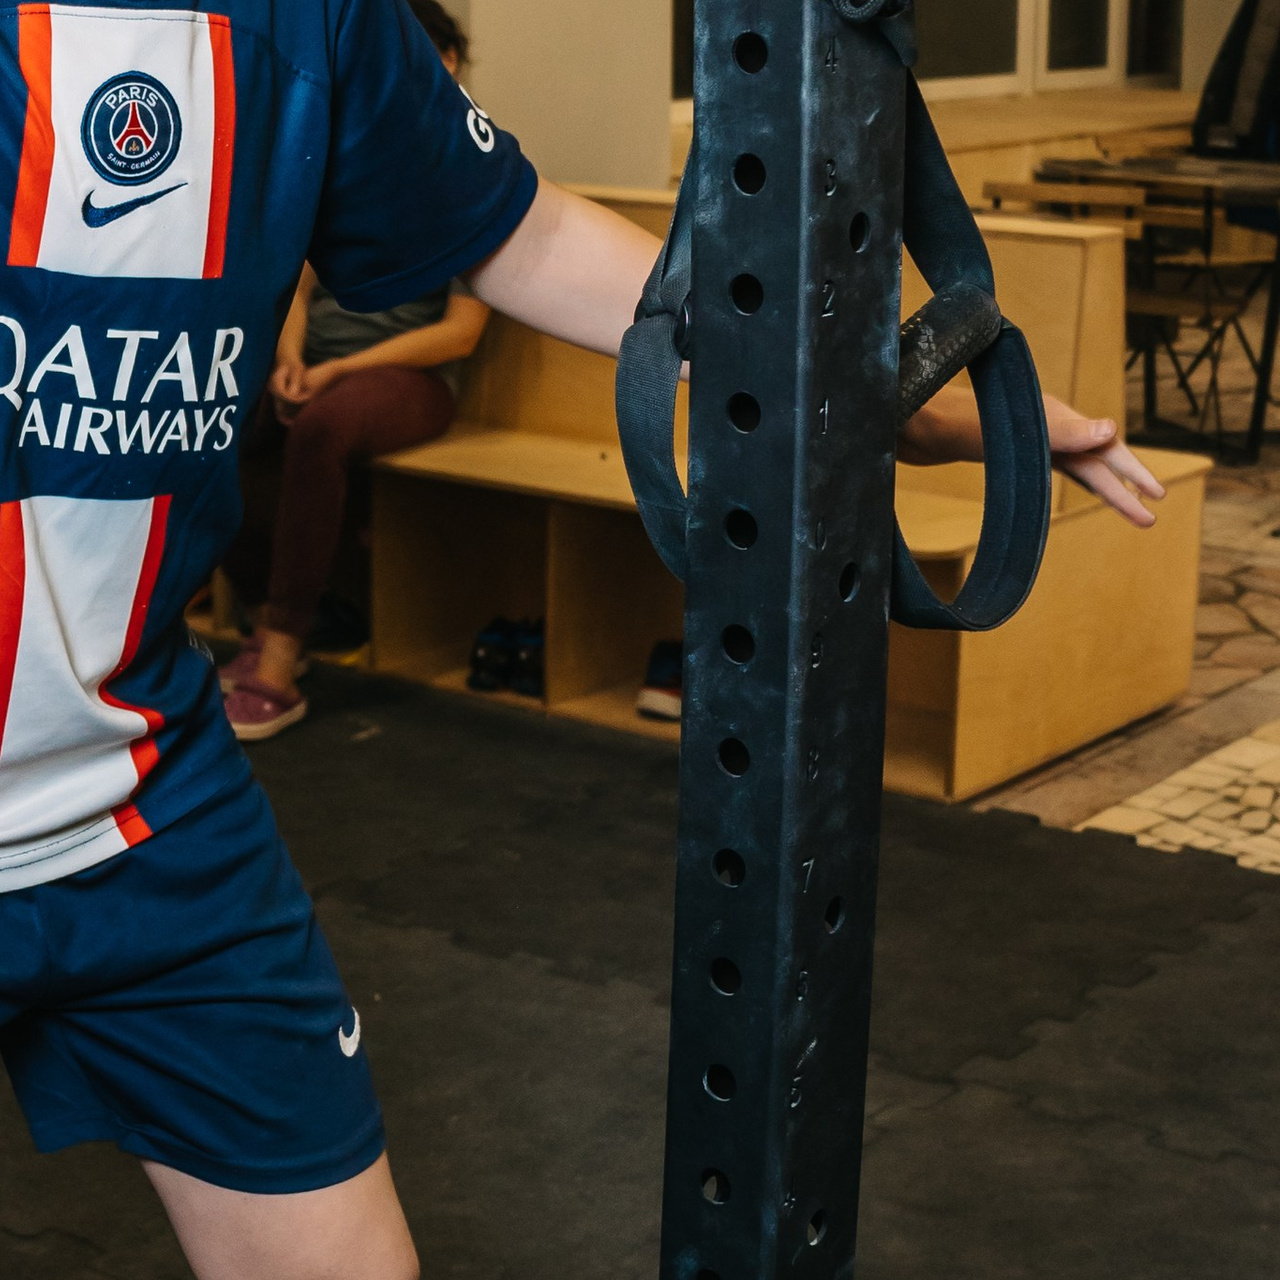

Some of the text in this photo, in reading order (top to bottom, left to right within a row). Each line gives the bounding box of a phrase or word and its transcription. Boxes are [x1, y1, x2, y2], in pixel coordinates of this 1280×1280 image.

[825, 34, 839, 74] 4
[105, 86, 158, 110] PARIS
[824, 158, 837, 197] 3
[821, 279, 836, 318] 2
[19, 399, 237, 455] AIRWAYS
[818, 396, 829, 436] 1
[801, 857, 815, 894] 7
